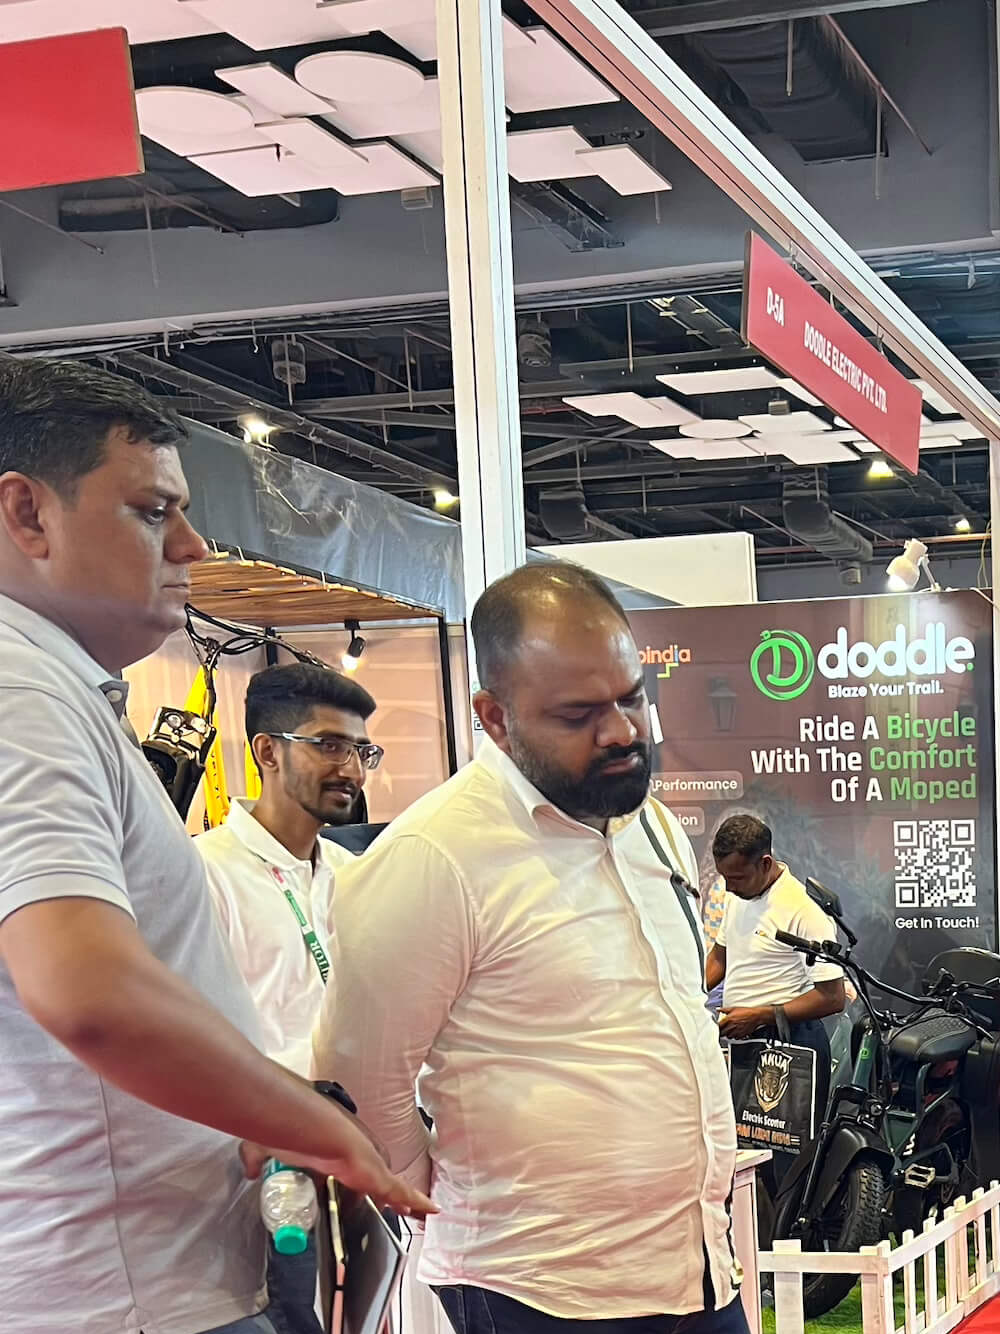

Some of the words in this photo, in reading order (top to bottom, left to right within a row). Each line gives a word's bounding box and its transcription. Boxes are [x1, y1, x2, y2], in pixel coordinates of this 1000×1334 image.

[766, 287, 785, 327] D-5A
[831, 344, 862, 393] ELECTRIC
[828, 685, 868, 699] Blaze
[870, 683, 905, 697] Your
[799, 715, 855, 742] Ride
[862, 716, 880, 741] A
[887, 711, 976, 743] Bicycle
[751, 747, 810, 774] With
[816, 746, 862, 772] The
[869, 744, 977, 771] Comfort
[655, 779, 738, 792] Performance
[831, 776, 859, 802] Of
[865, 777, 884, 801] A
[890, 773, 977, 804] Moped
[895, 917, 919, 929] Get
[920, 917, 933, 929] In
[934, 916, 979, 929] Touch!
